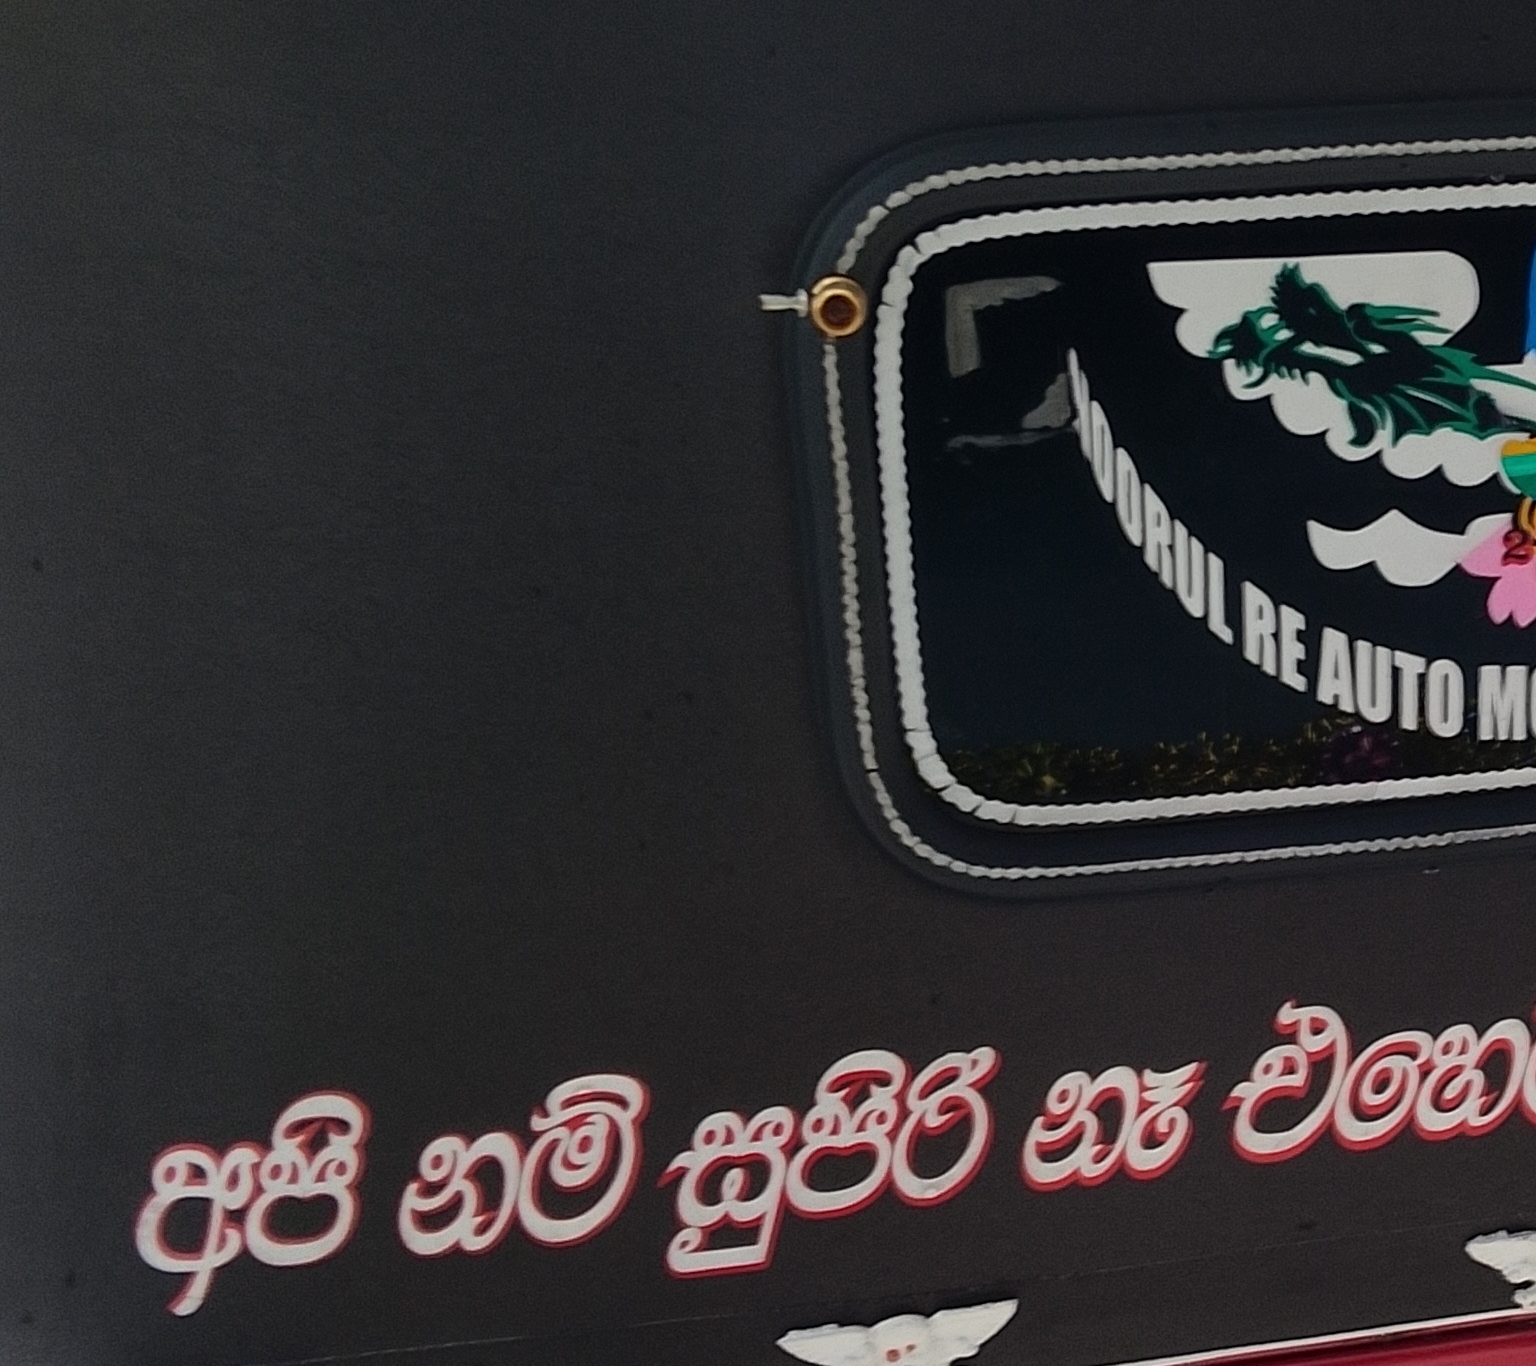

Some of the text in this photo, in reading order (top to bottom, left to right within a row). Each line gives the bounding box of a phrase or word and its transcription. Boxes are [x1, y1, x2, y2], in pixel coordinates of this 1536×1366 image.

[1240, 580, 1307, 692] RE
[1315, 625, 1465, 737] AUTO
[135, 1090, 370, 1316] අපි
[397, 1072, 650, 1256] නම්
[660, 1046, 998, 1277] සුපිරි
